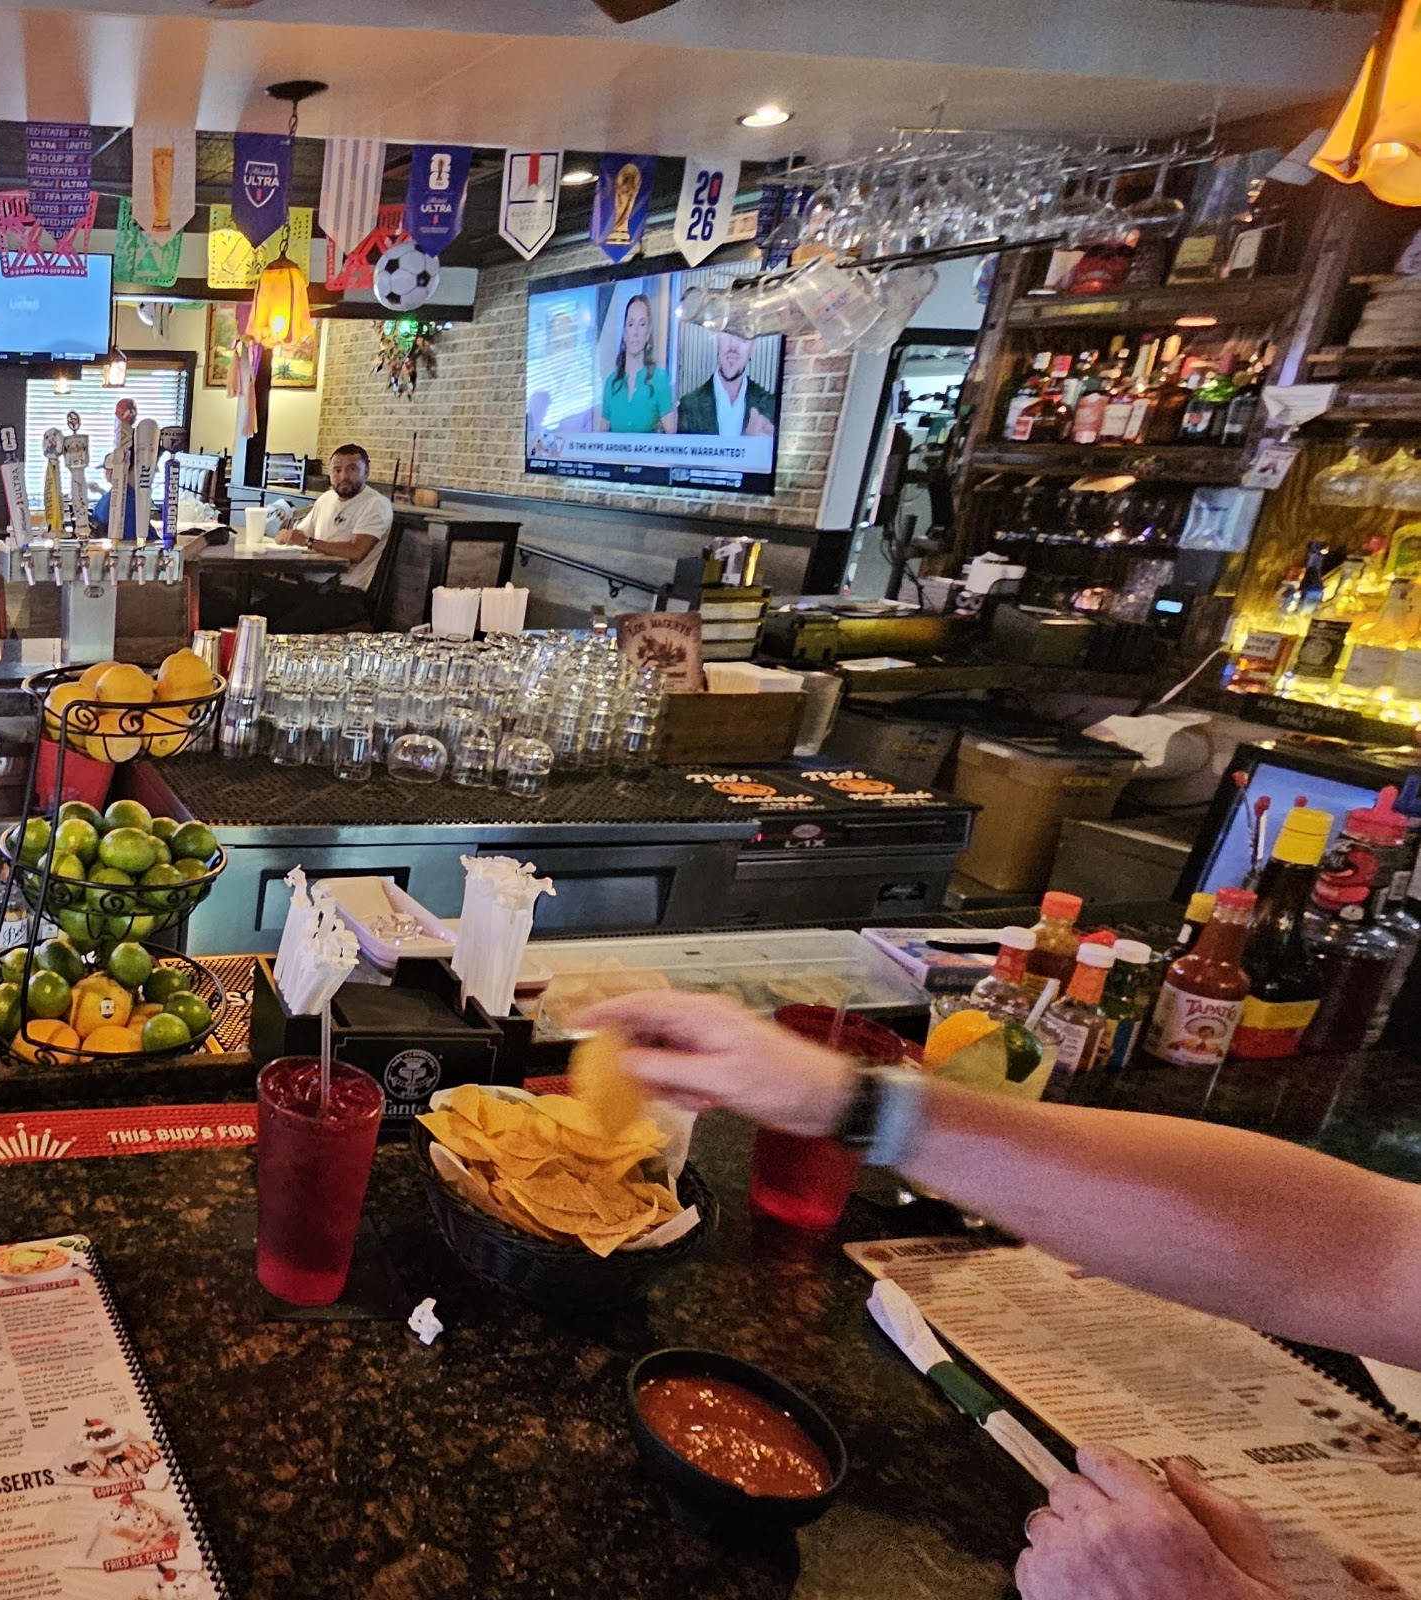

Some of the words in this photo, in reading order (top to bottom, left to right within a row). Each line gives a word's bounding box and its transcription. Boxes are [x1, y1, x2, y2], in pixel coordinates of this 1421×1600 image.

[30, 141, 56, 150] ULTRA
[244, 176, 279, 187] ULTRA
[694, 170, 724, 205] 20
[420, 204, 451, 213] ULTRA
[686, 206, 716, 241] 26
[576, 442, 587, 450] THE
[588, 443, 604, 451] HYPE
[606, 443, 632, 452] AROUND
[634, 444, 652, 453] ARCH
[654, 445, 689, 456] MANNING
[12, 467, 24, 498] ULTRA
[167, 466, 179, 503] LIGHT
[166, 504, 178, 534] BUD
[686, 773, 751, 783] Tito's
[801, 770, 866, 781] Tito's
[107, 1129, 152, 1144] THIS
[156, 1126, 214, 1143] BUD'S
[217, 1124, 257, 1141] FOR
[105, 1558, 129, 1571] FRIED
[131, 1555, 142, 1565] ICE
[146, 1549, 176, 1563] CREAM
